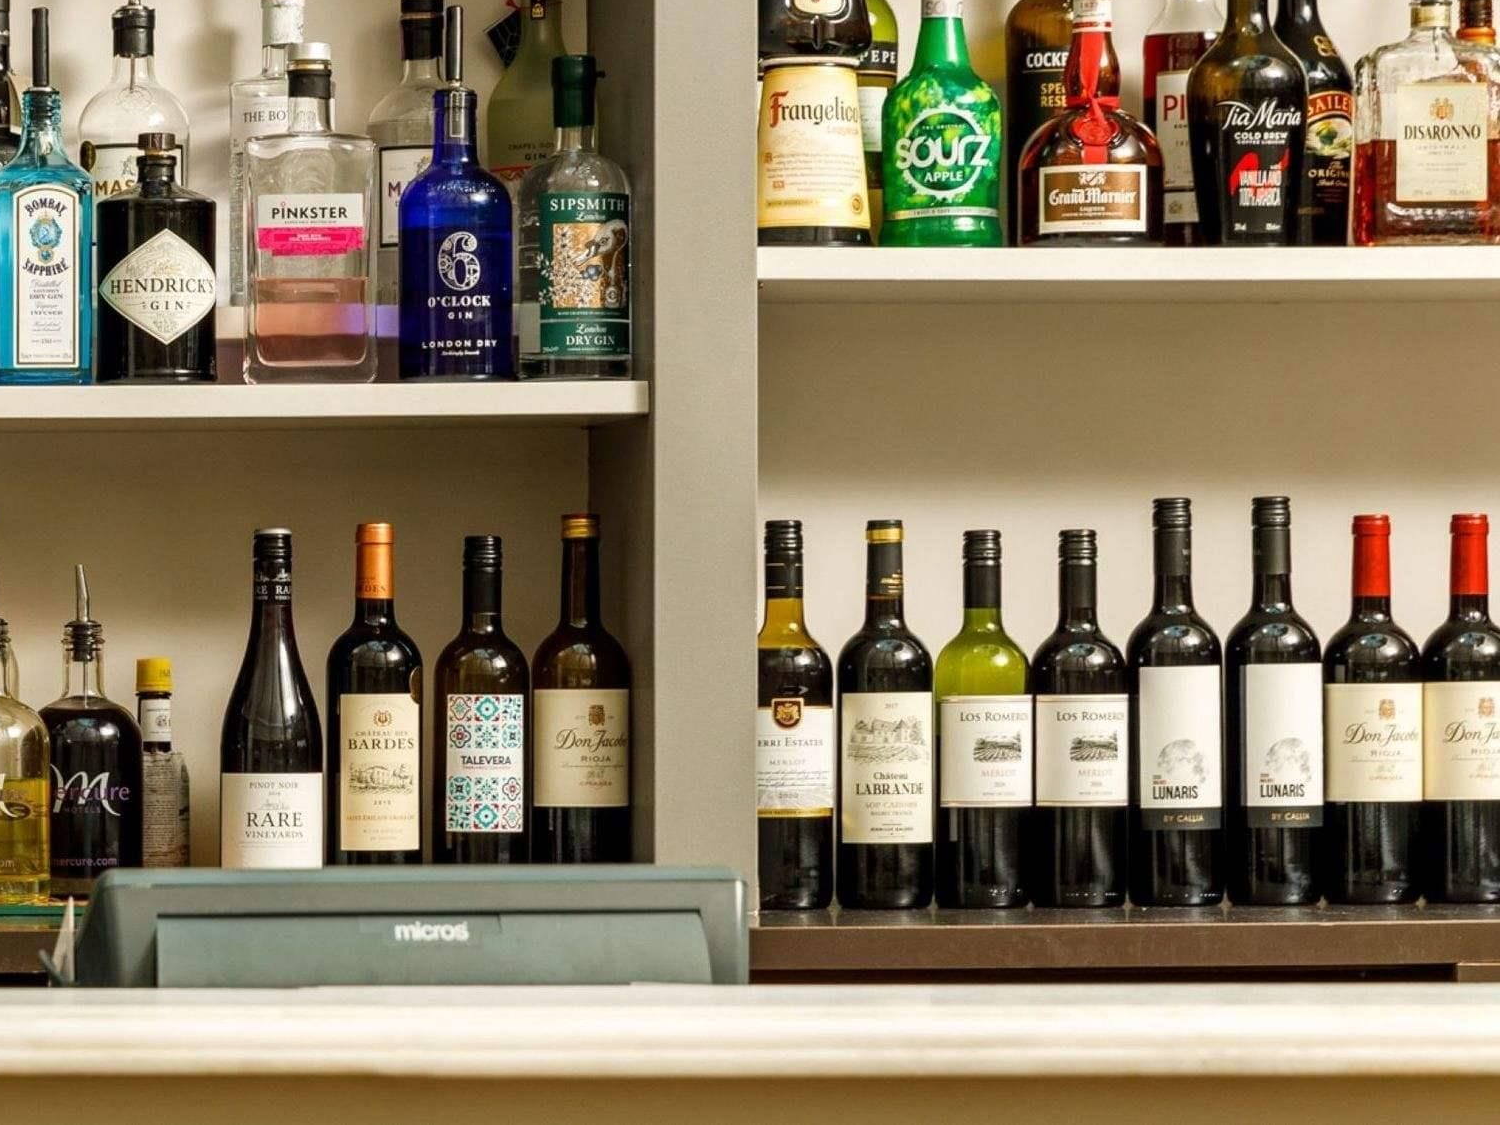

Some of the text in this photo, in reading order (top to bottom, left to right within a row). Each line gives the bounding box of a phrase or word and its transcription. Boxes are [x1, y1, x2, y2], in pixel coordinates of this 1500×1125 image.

[769, 90, 858, 129] Frangelico
[1217, 100, 1250, 130] Tia
[1246, 99, 1300, 130] Maria
[242, 111, 264, 124] THE
[1234, 130, 1289, 141] COLD BREW
[1404, 124, 1482, 141] DISARONNO
[924, 170, 965, 183] APPLE
[24, 196, 67, 218] BOMBAY
[271, 202, 348, 220] PINKSTER
[550, 196, 626, 213] SIPSMITH
[22, 256, 69, 277] SAPPHIRE
[437, 231, 482, 291] 6
[110, 276, 213, 296] HENDRICK'S
[150, 301, 184, 311] GIN
[428, 294, 492, 309] O'CLOCK
[449, 311, 474, 320] GIN
[421, 338, 498, 348] LONDON DRY
[565, 334, 616, 346] DRY GIN
[960, 712, 982, 723] LOS
[1056, 711, 1079, 722] LOS
[554, 727, 591, 750] Don
[1343, 722, 1377, 745] Don
[1444, 720, 1481, 744] Don
[348, 738, 415, 751] BARDES
[461, 755, 512, 766] TALEVERA
[580, 754, 611, 764] RIOJA
[769, 758, 806, 766] MERLOT
[249, 781, 300, 790] PINOT NOIR
[855, 782, 924, 796] LABRANDE
[1260, 783, 1306, 798] LUNARIS
[1152, 786, 1199, 800] LUNARIS
[246, 811, 304, 829] RARE
[244, 829, 304, 840] VINEYARDS
[394, 921, 470, 943] micros
